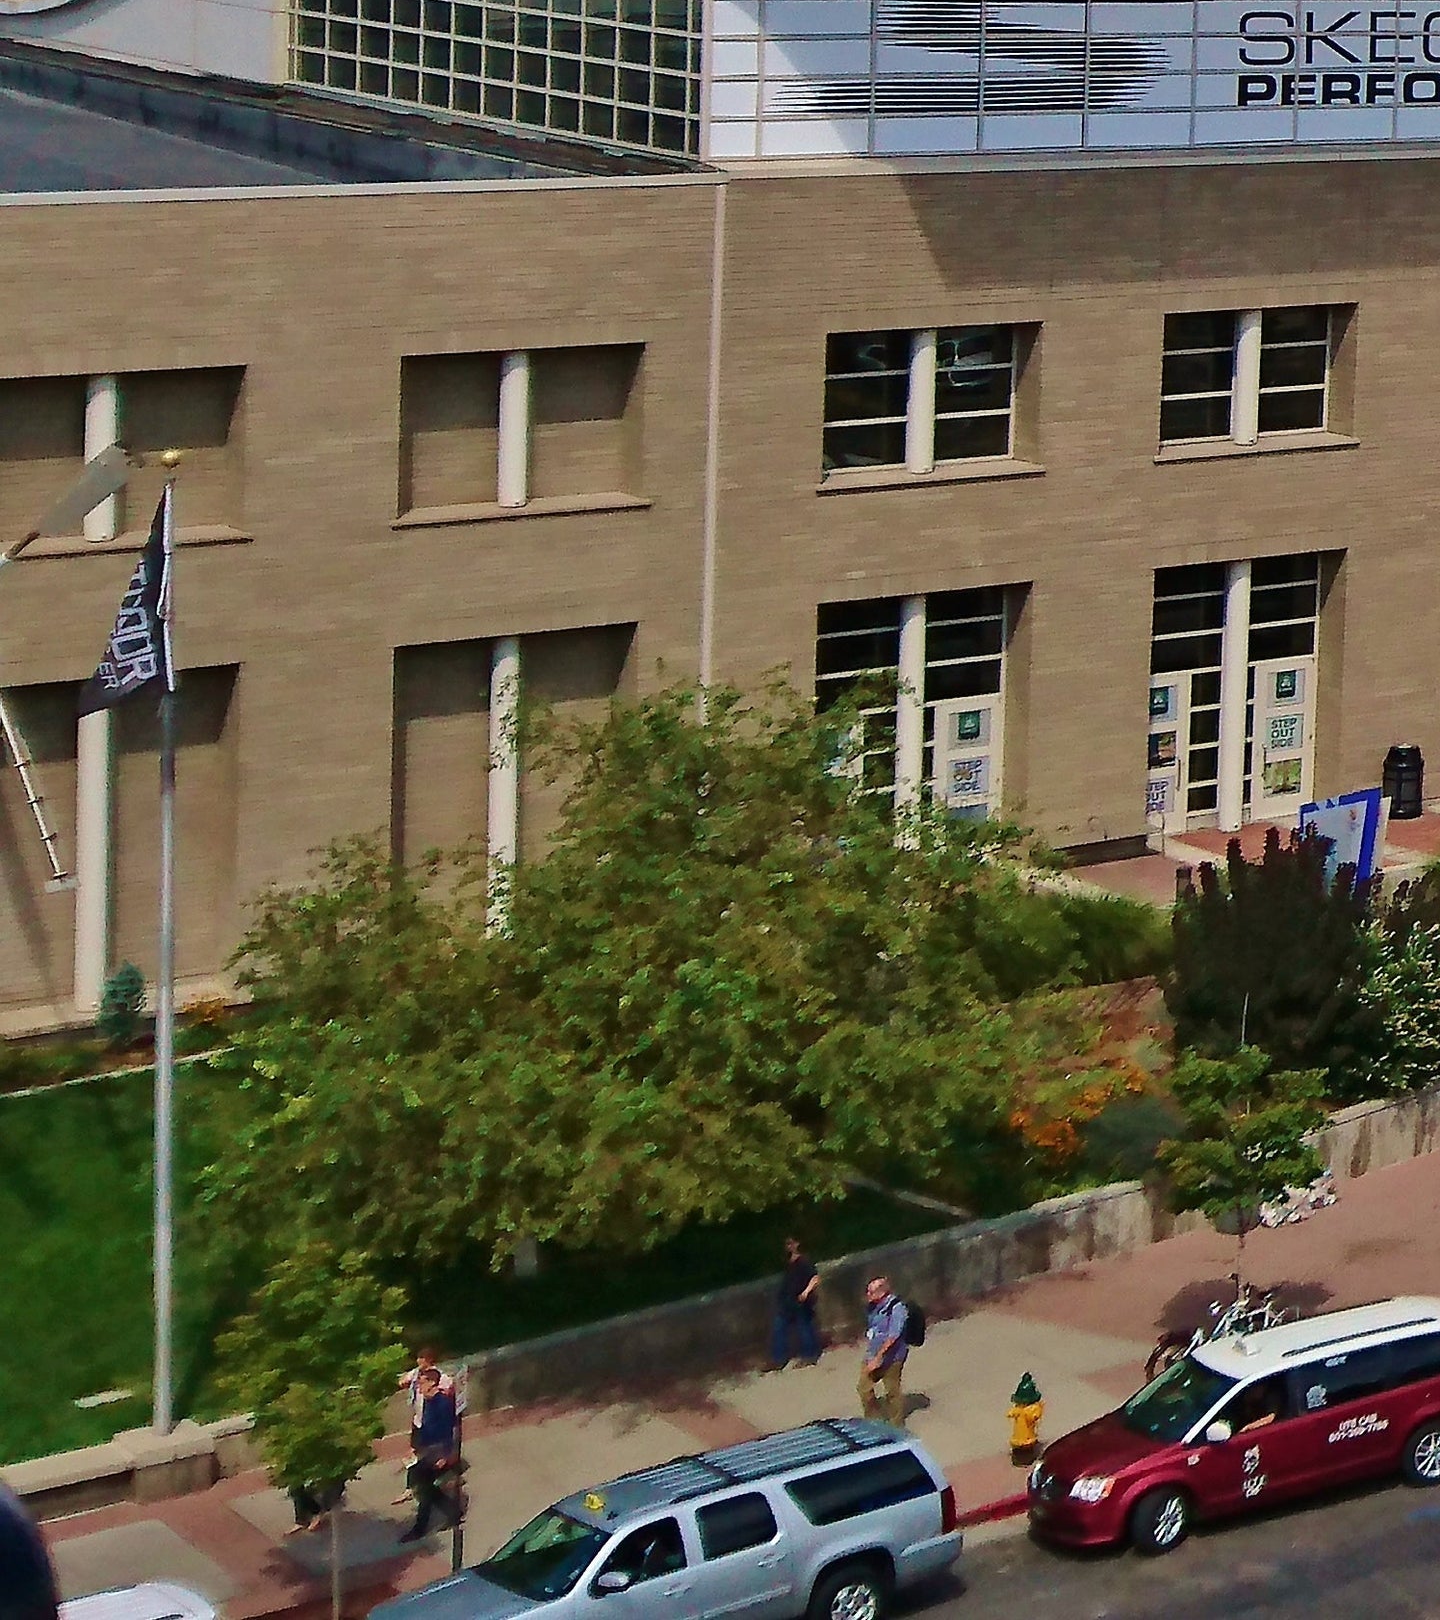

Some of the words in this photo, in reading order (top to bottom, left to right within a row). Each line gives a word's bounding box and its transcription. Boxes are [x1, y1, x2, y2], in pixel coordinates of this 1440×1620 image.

[1271, 718, 1298, 729] STEP
[1271, 728, 1295, 739] OUT
[1270, 738, 1295, 750] SIDE
[953, 780, 980, 793] SIDE
